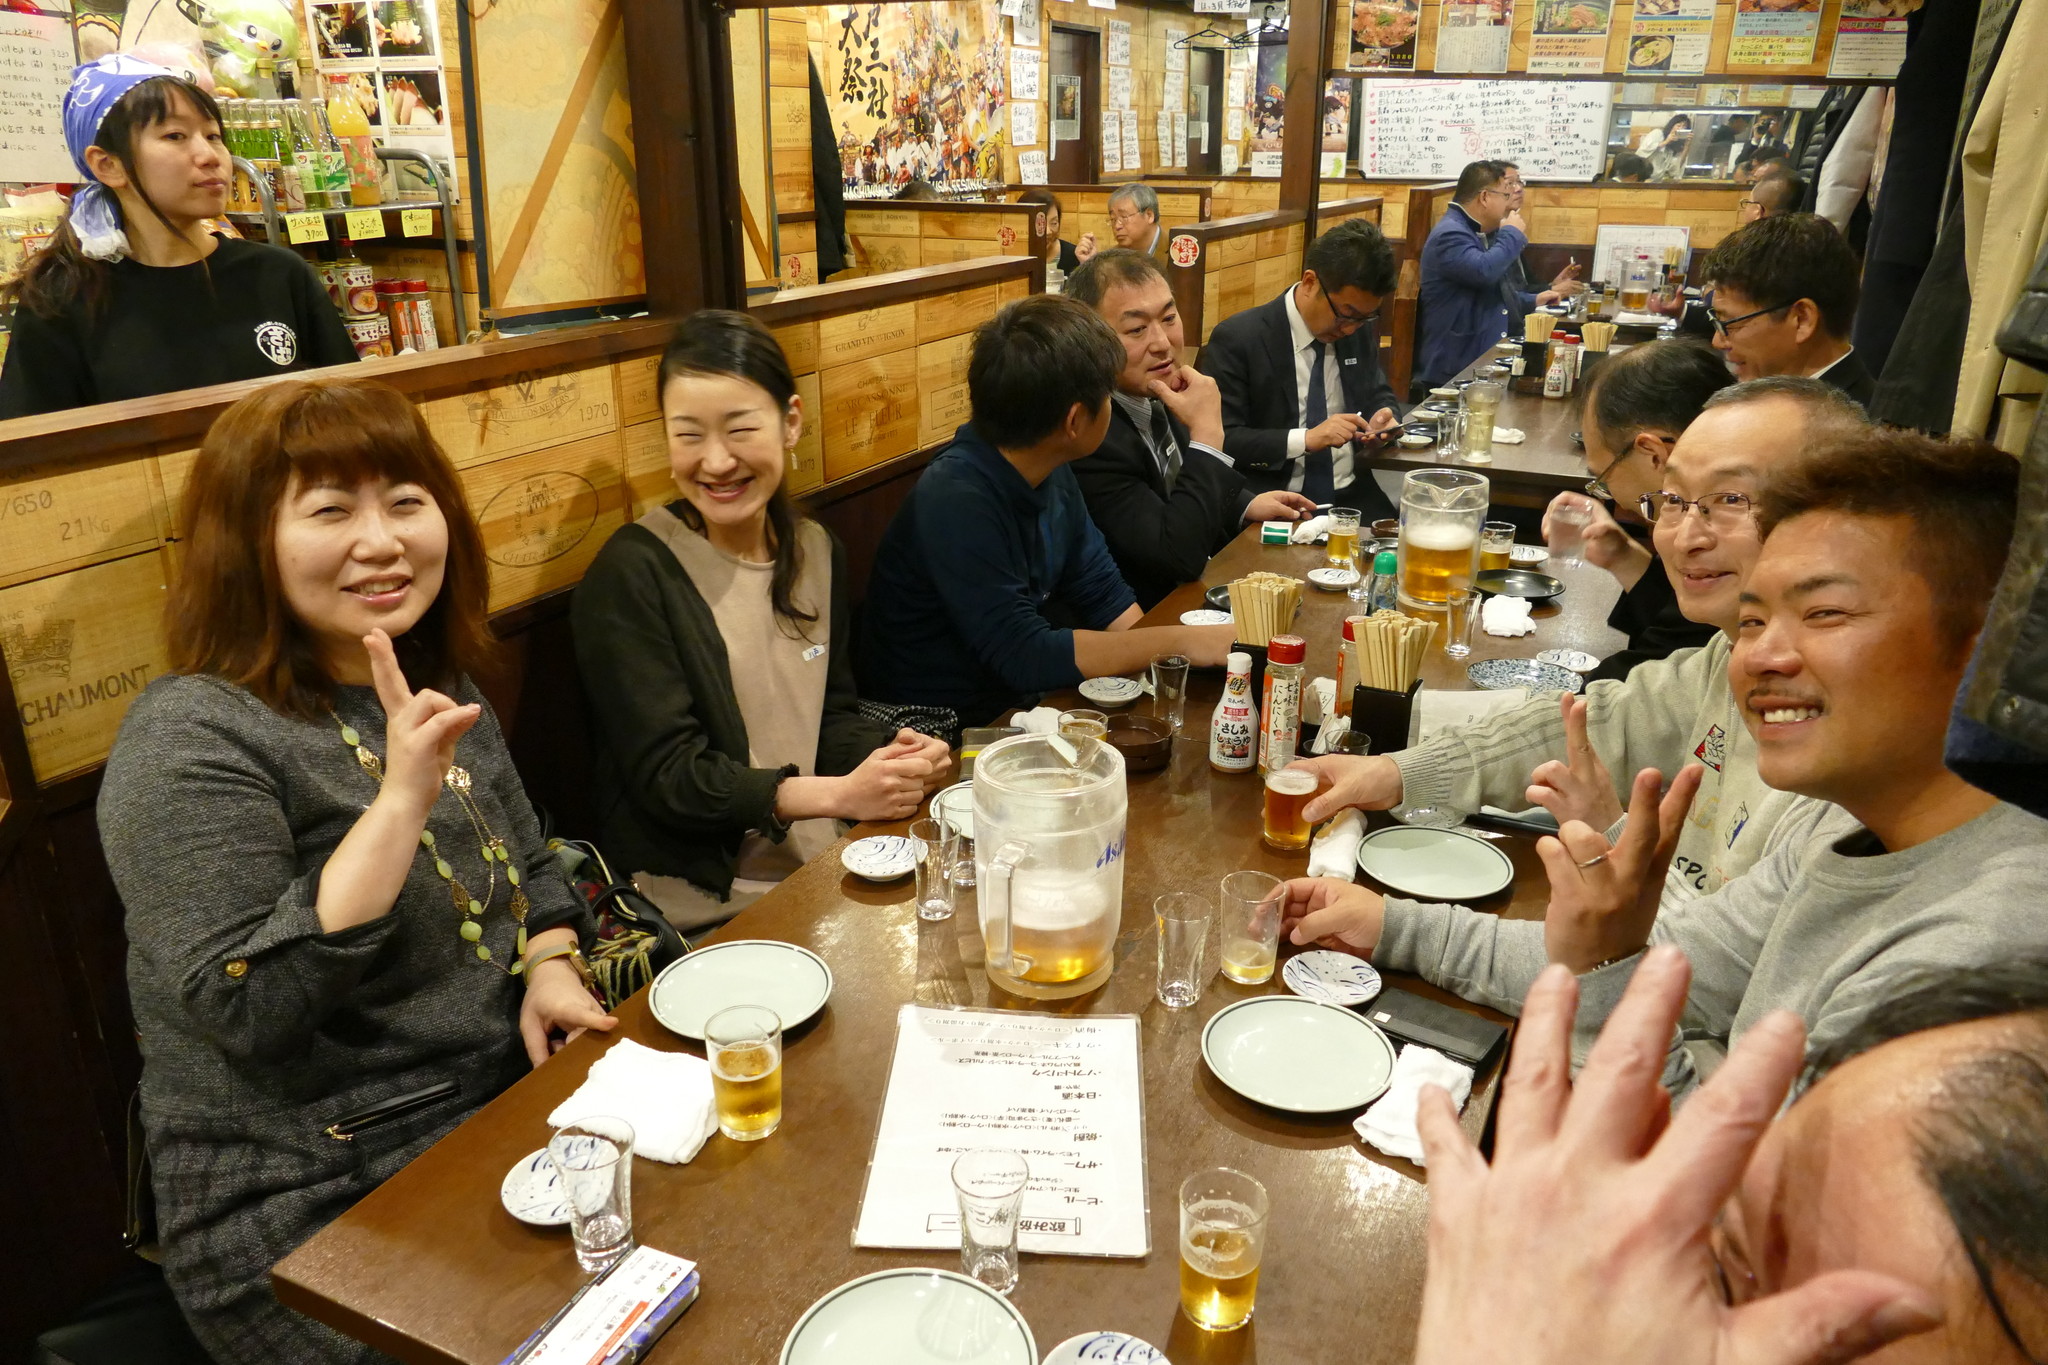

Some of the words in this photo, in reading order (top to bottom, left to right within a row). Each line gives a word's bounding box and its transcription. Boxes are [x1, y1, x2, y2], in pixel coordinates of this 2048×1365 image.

[579, 402, 609, 421] 1970
[845, 416, 858, 438] LE
[19, 664, 151, 727] CHAUMONT
[1273, 684, 1283, 729] にんにく
[1221, 723, 1249, 736] さしみ
[1216, 733, 1252, 747] しょうゆ
